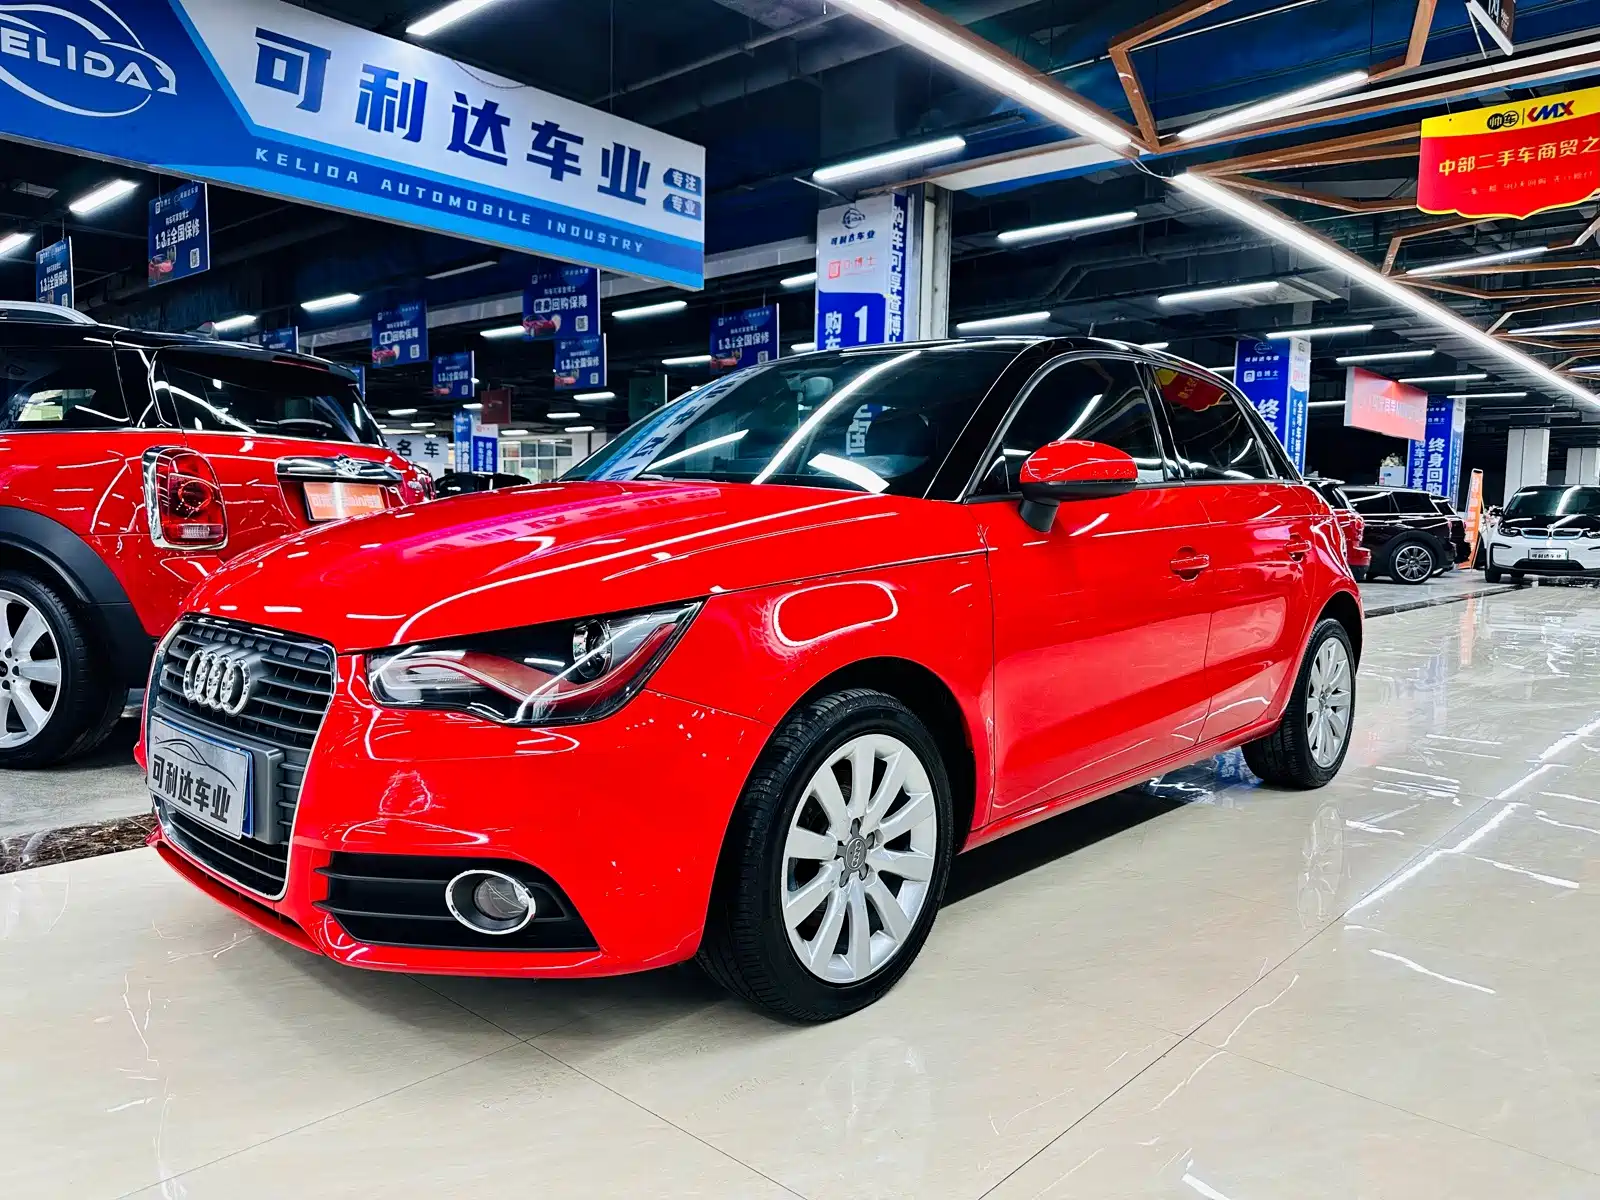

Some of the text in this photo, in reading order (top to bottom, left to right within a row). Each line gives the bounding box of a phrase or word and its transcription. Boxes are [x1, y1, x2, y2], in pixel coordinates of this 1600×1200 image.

[254, 27, 651, 205] 可利达车业
[1438, 135, 1600, 177] 中部二手车商贸之
[256, 147, 645, 254] KELIDA AUTOMOBILE INDUSTRY
[672, 169, 697, 192] 专注
[671, 194, 696, 216] 专业
[830, 229, 876, 246] 可利达车业
[888, 206, 904, 343] 购车可享查博
[854, 305, 868, 342] 1
[396, 438, 440, 458] 名车
[1425, 437, 1446, 496] 终身回购
[152, 754, 231, 824] 可利达车业
